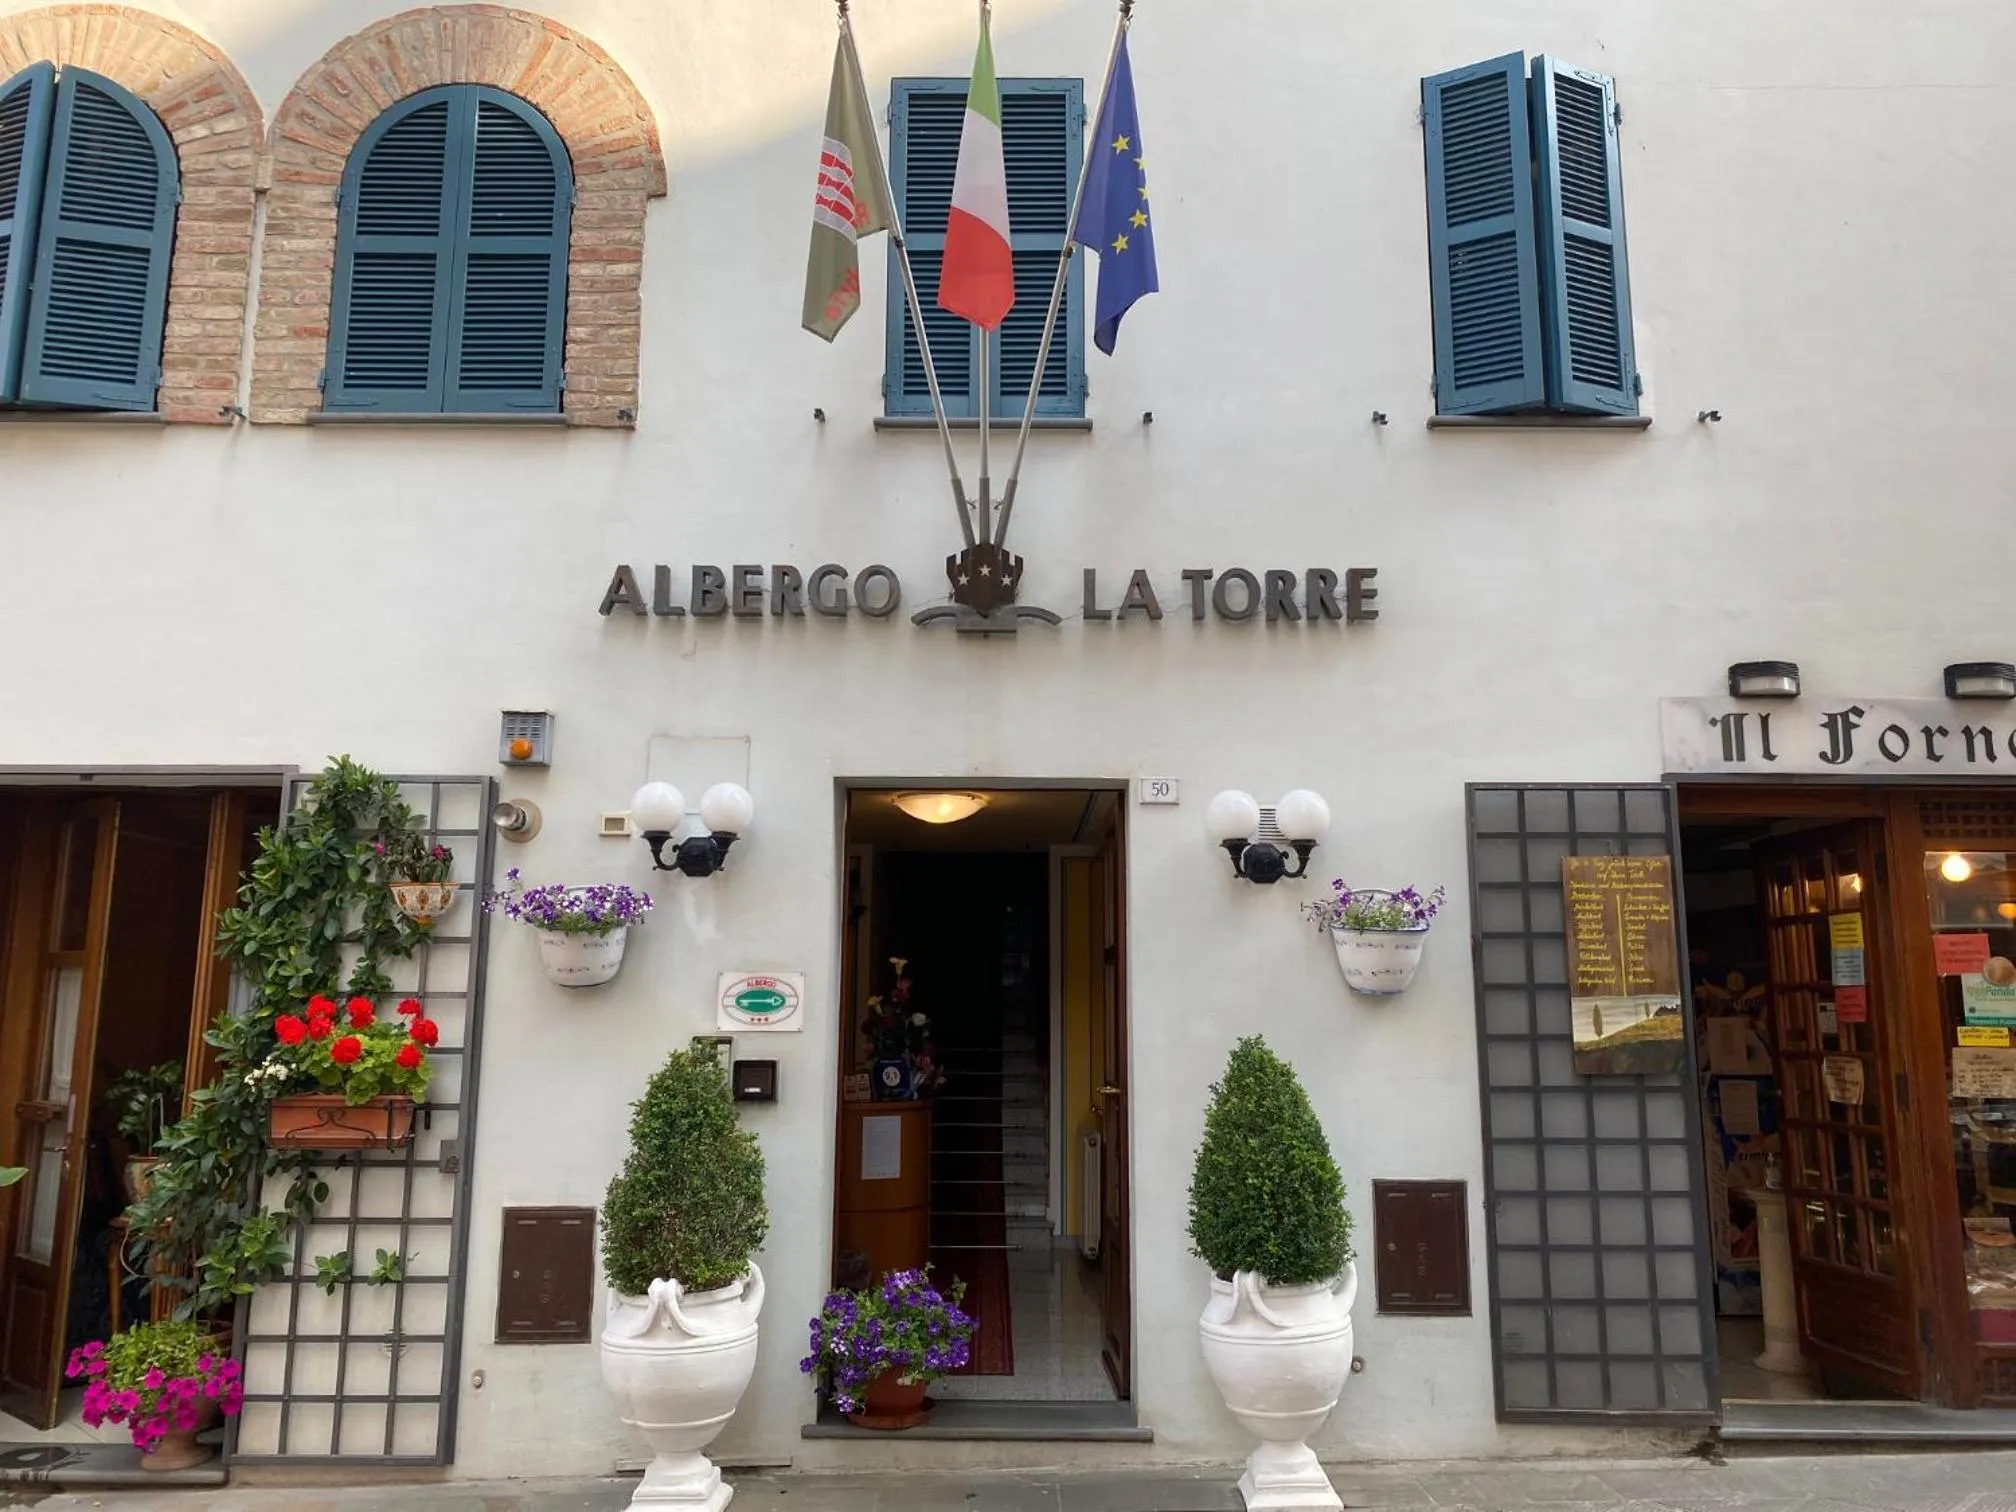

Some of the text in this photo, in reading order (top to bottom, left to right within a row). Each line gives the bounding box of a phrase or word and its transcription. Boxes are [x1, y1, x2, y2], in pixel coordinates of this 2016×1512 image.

[598, 564, 1379, 621] ALBERGO LA TORRE
[1709, 705, 2016, 764] Il Forn
[1152, 781, 1169, 796] 50
[746, 979, 777, 988] ALBERGO
